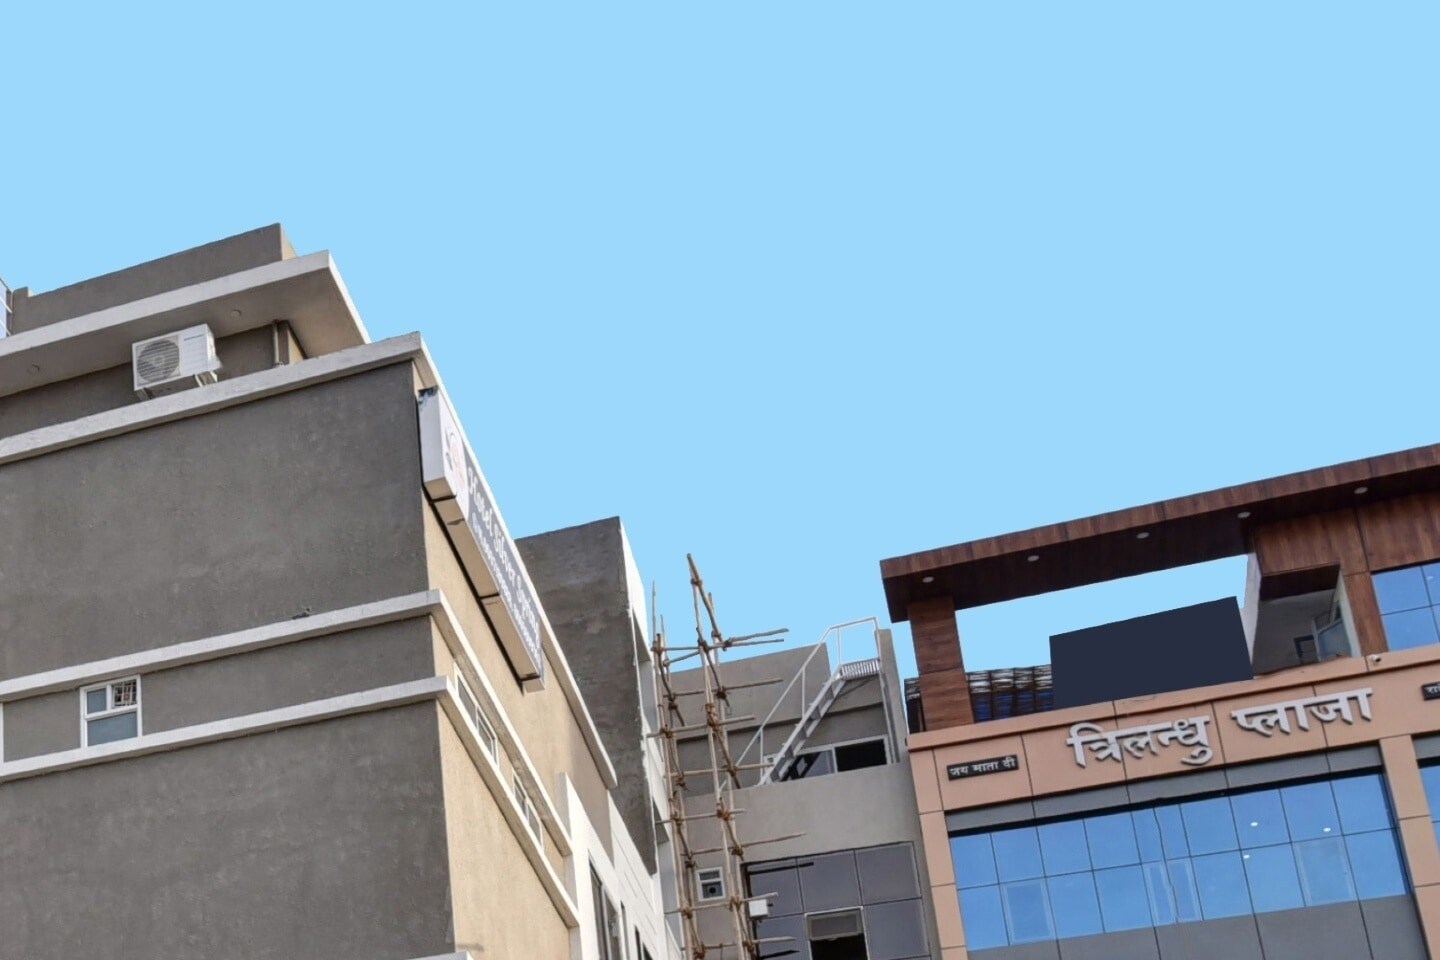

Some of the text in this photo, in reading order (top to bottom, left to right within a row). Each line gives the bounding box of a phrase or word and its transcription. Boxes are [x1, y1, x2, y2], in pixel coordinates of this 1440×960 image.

[1231, 687, 1373, 737] प्लाजा
[949, 766, 969, 776] जय
[972, 761, 999, 772] माता
